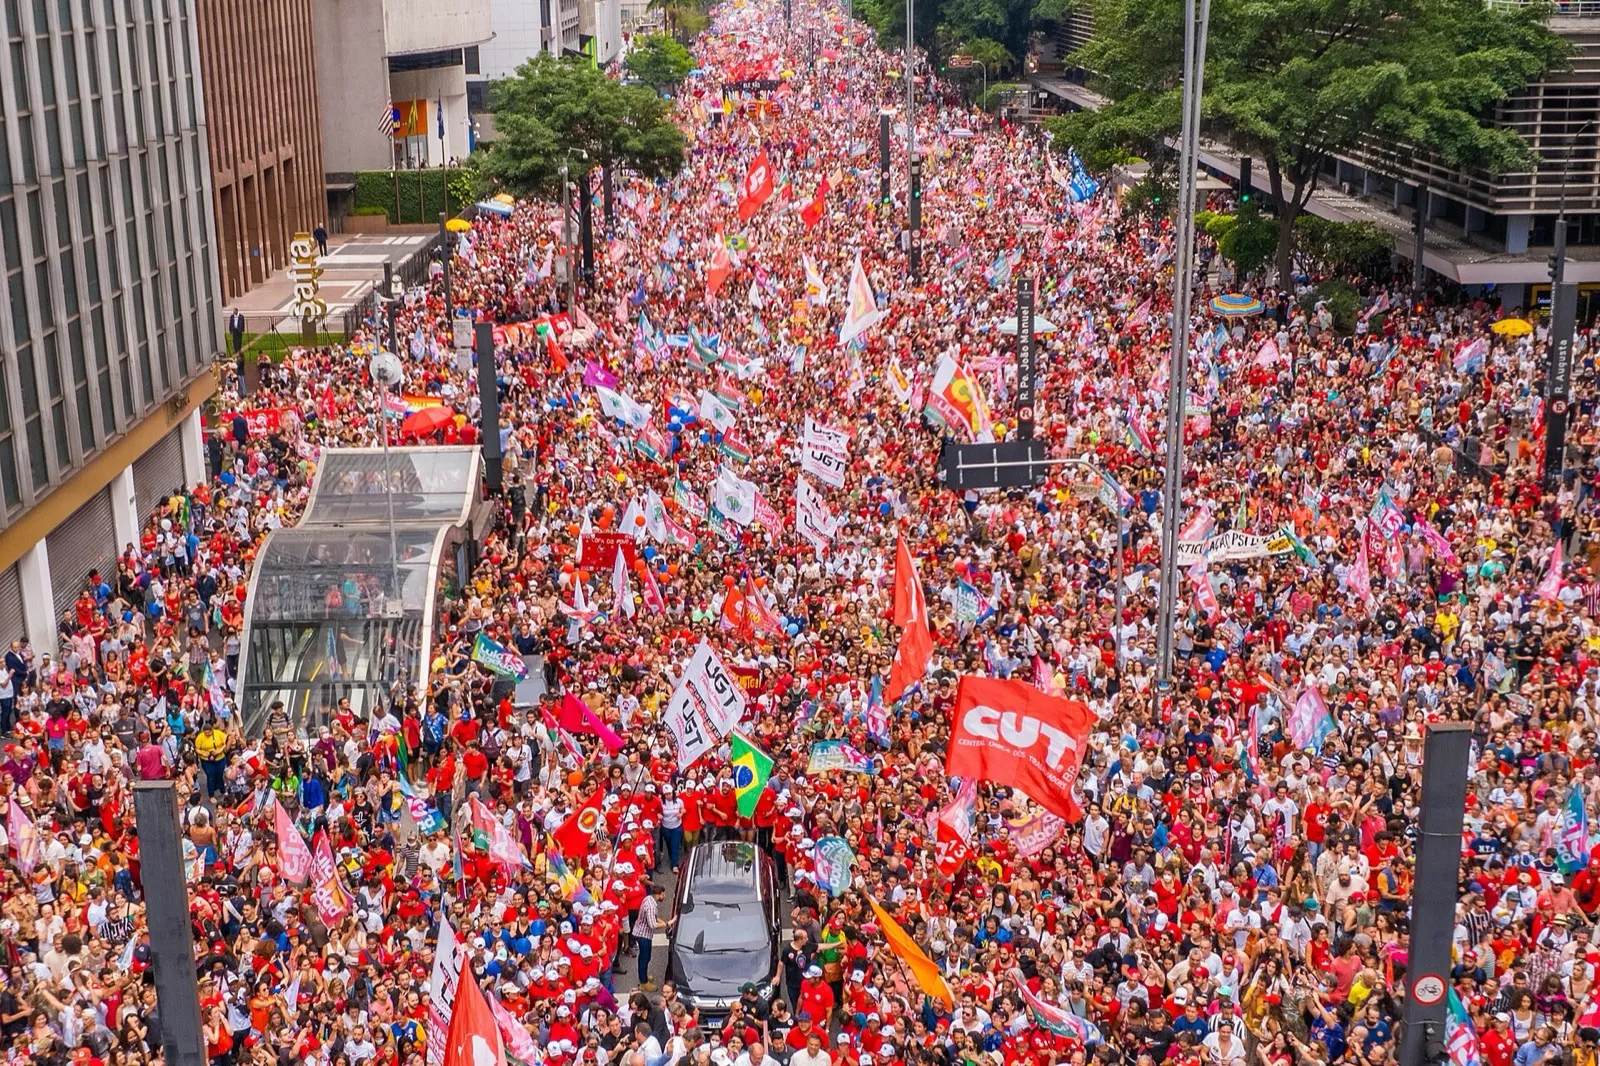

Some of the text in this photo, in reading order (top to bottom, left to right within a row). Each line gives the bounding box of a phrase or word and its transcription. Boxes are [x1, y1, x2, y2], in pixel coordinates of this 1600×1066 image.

[1020, 306, 1029, 401] R. Pe. João Manuel
[1554, 339, 1568, 394] R. Augusta
[811, 450, 844, 471] UGT
[704, 655, 738, 707] UGT
[682, 698, 704, 748] UGT
[962, 705, 1077, 770] CUT
[1062, 765, 1077, 782] BR
